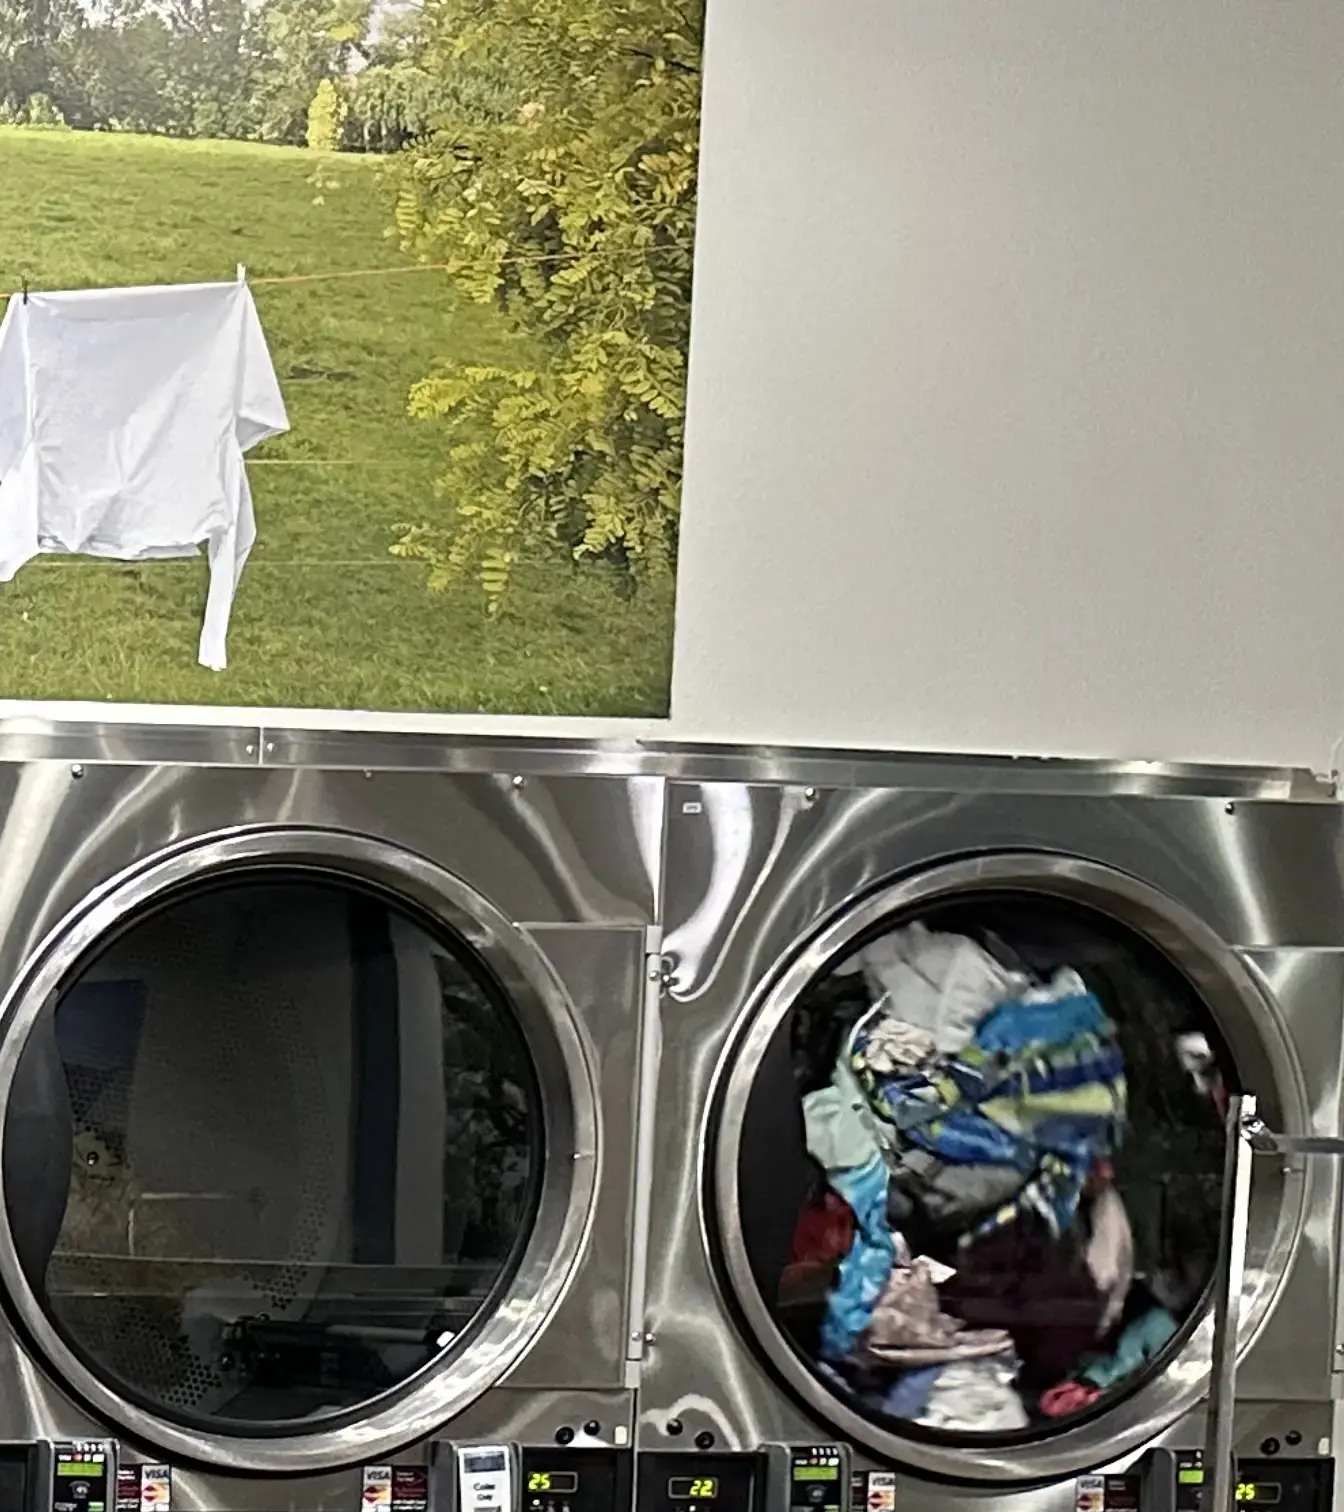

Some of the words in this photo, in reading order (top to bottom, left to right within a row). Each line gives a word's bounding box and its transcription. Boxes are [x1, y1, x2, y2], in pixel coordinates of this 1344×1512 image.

[145, 1469, 169, 1479] VISA
[528, 1473, 551, 1490] 25
[689, 1480, 712, 1497] 22
[1235, 1483, 1256, 1500] 25
